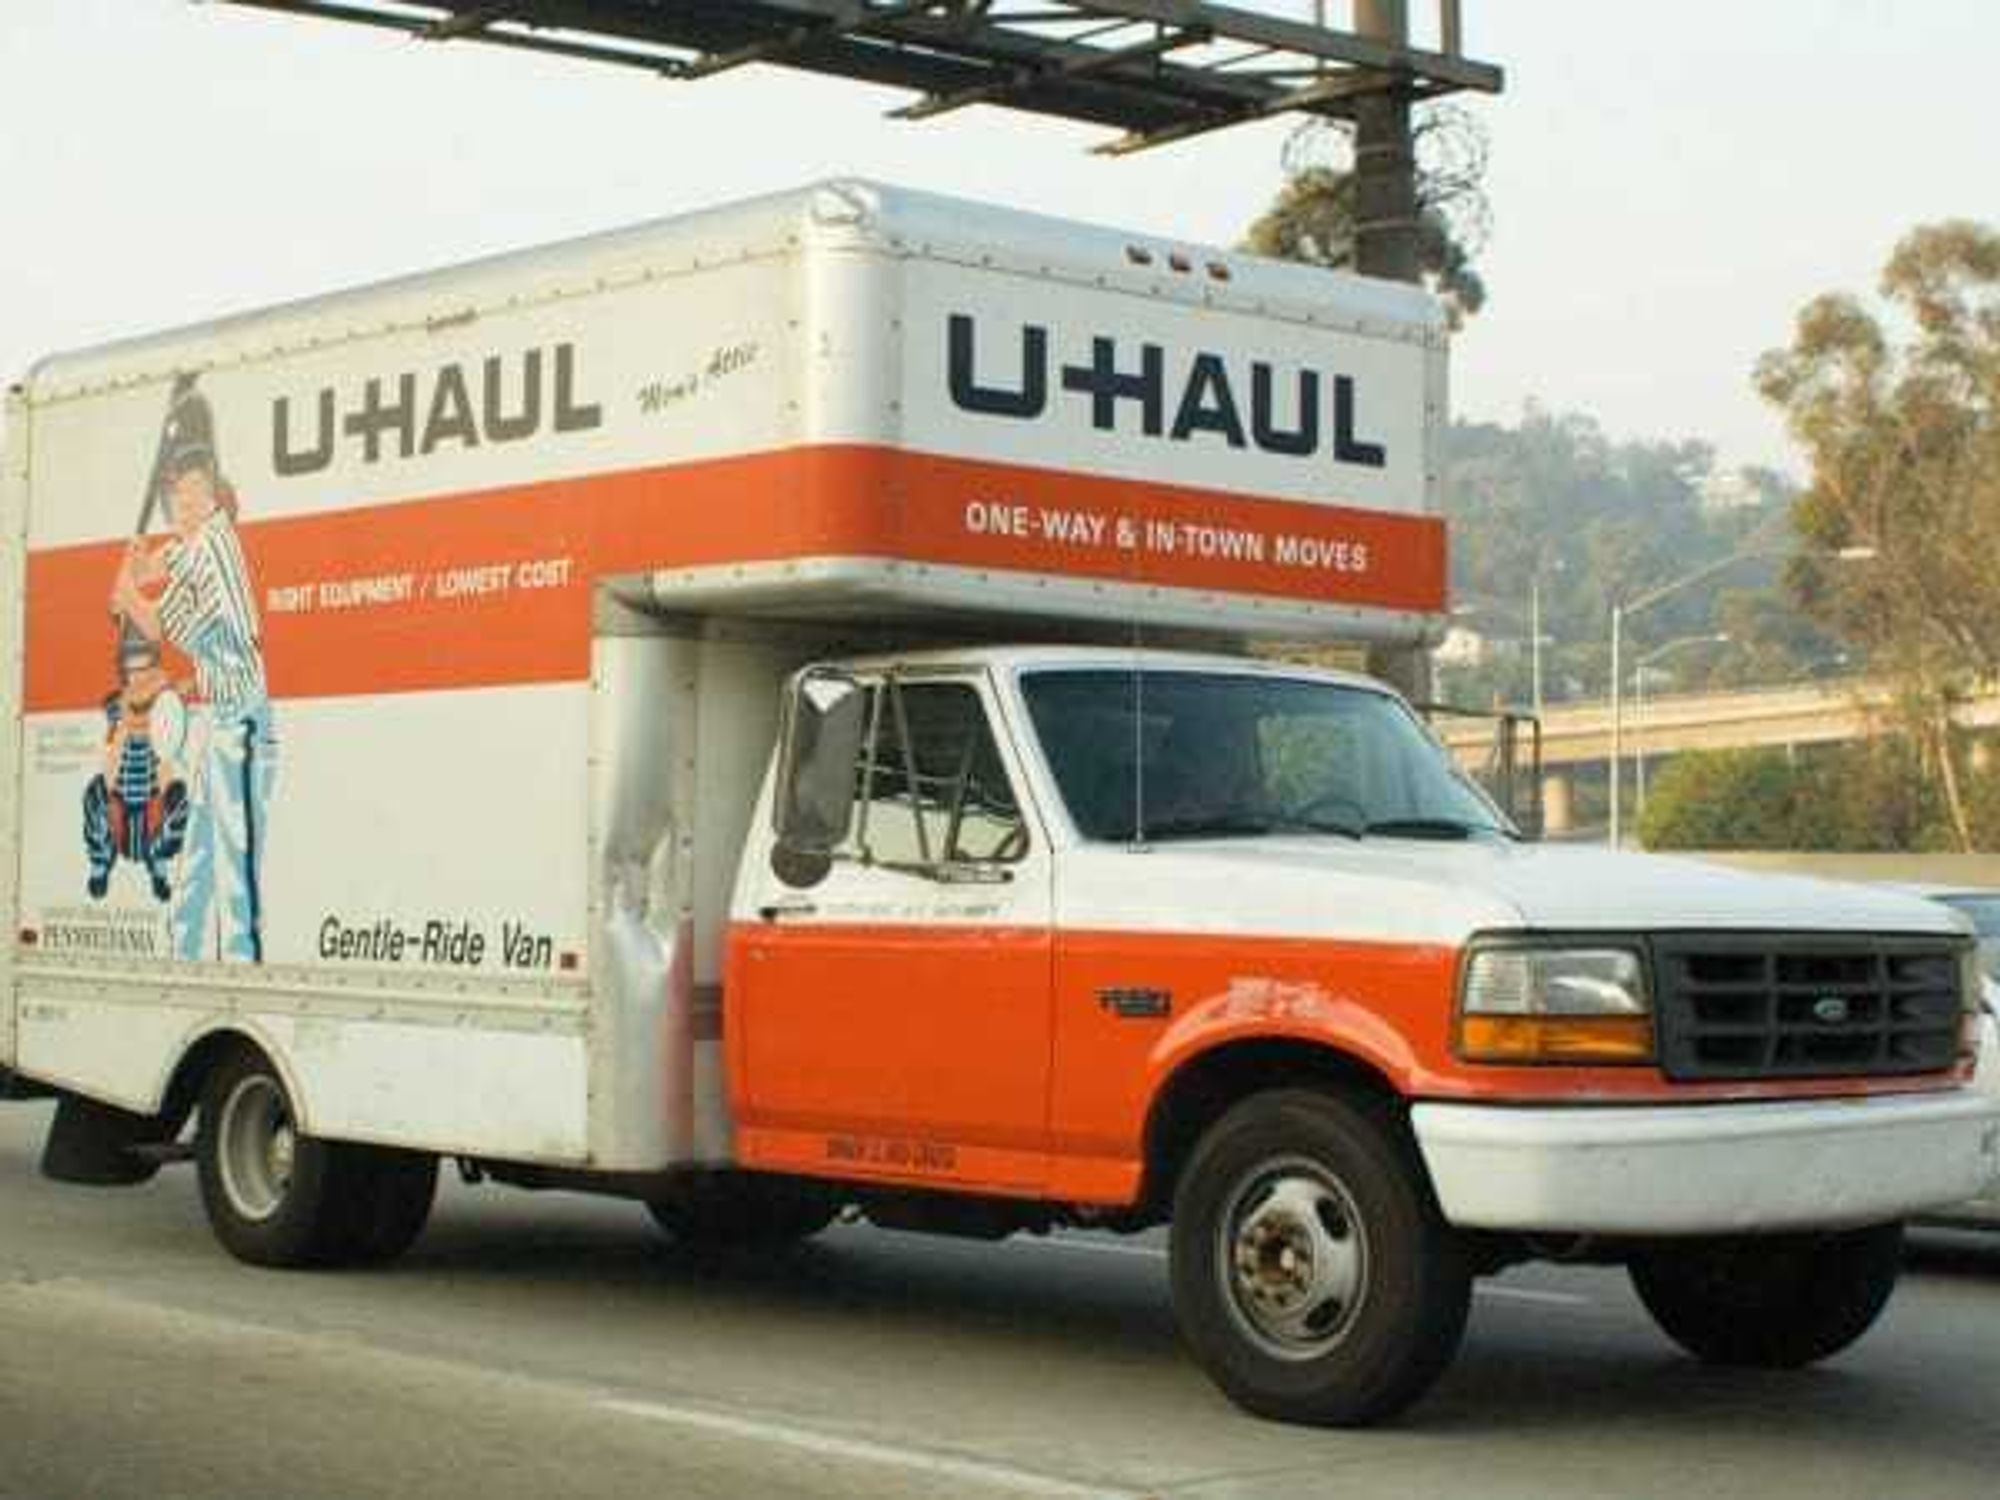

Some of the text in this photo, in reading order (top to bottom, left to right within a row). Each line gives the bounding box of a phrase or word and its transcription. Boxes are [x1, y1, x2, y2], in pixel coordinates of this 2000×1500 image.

[272, 343, 602, 478] U-HAUL
[947, 314, 1386, 468] U-HAUL
[965, 501, 1369, 573] ONE-WAY & IN-TOWN MOVES
[436, 563, 511, 598] LOWEST
[518, 558, 572, 589] COST
[319, 915, 553, 969] Gentle-Ride Van
